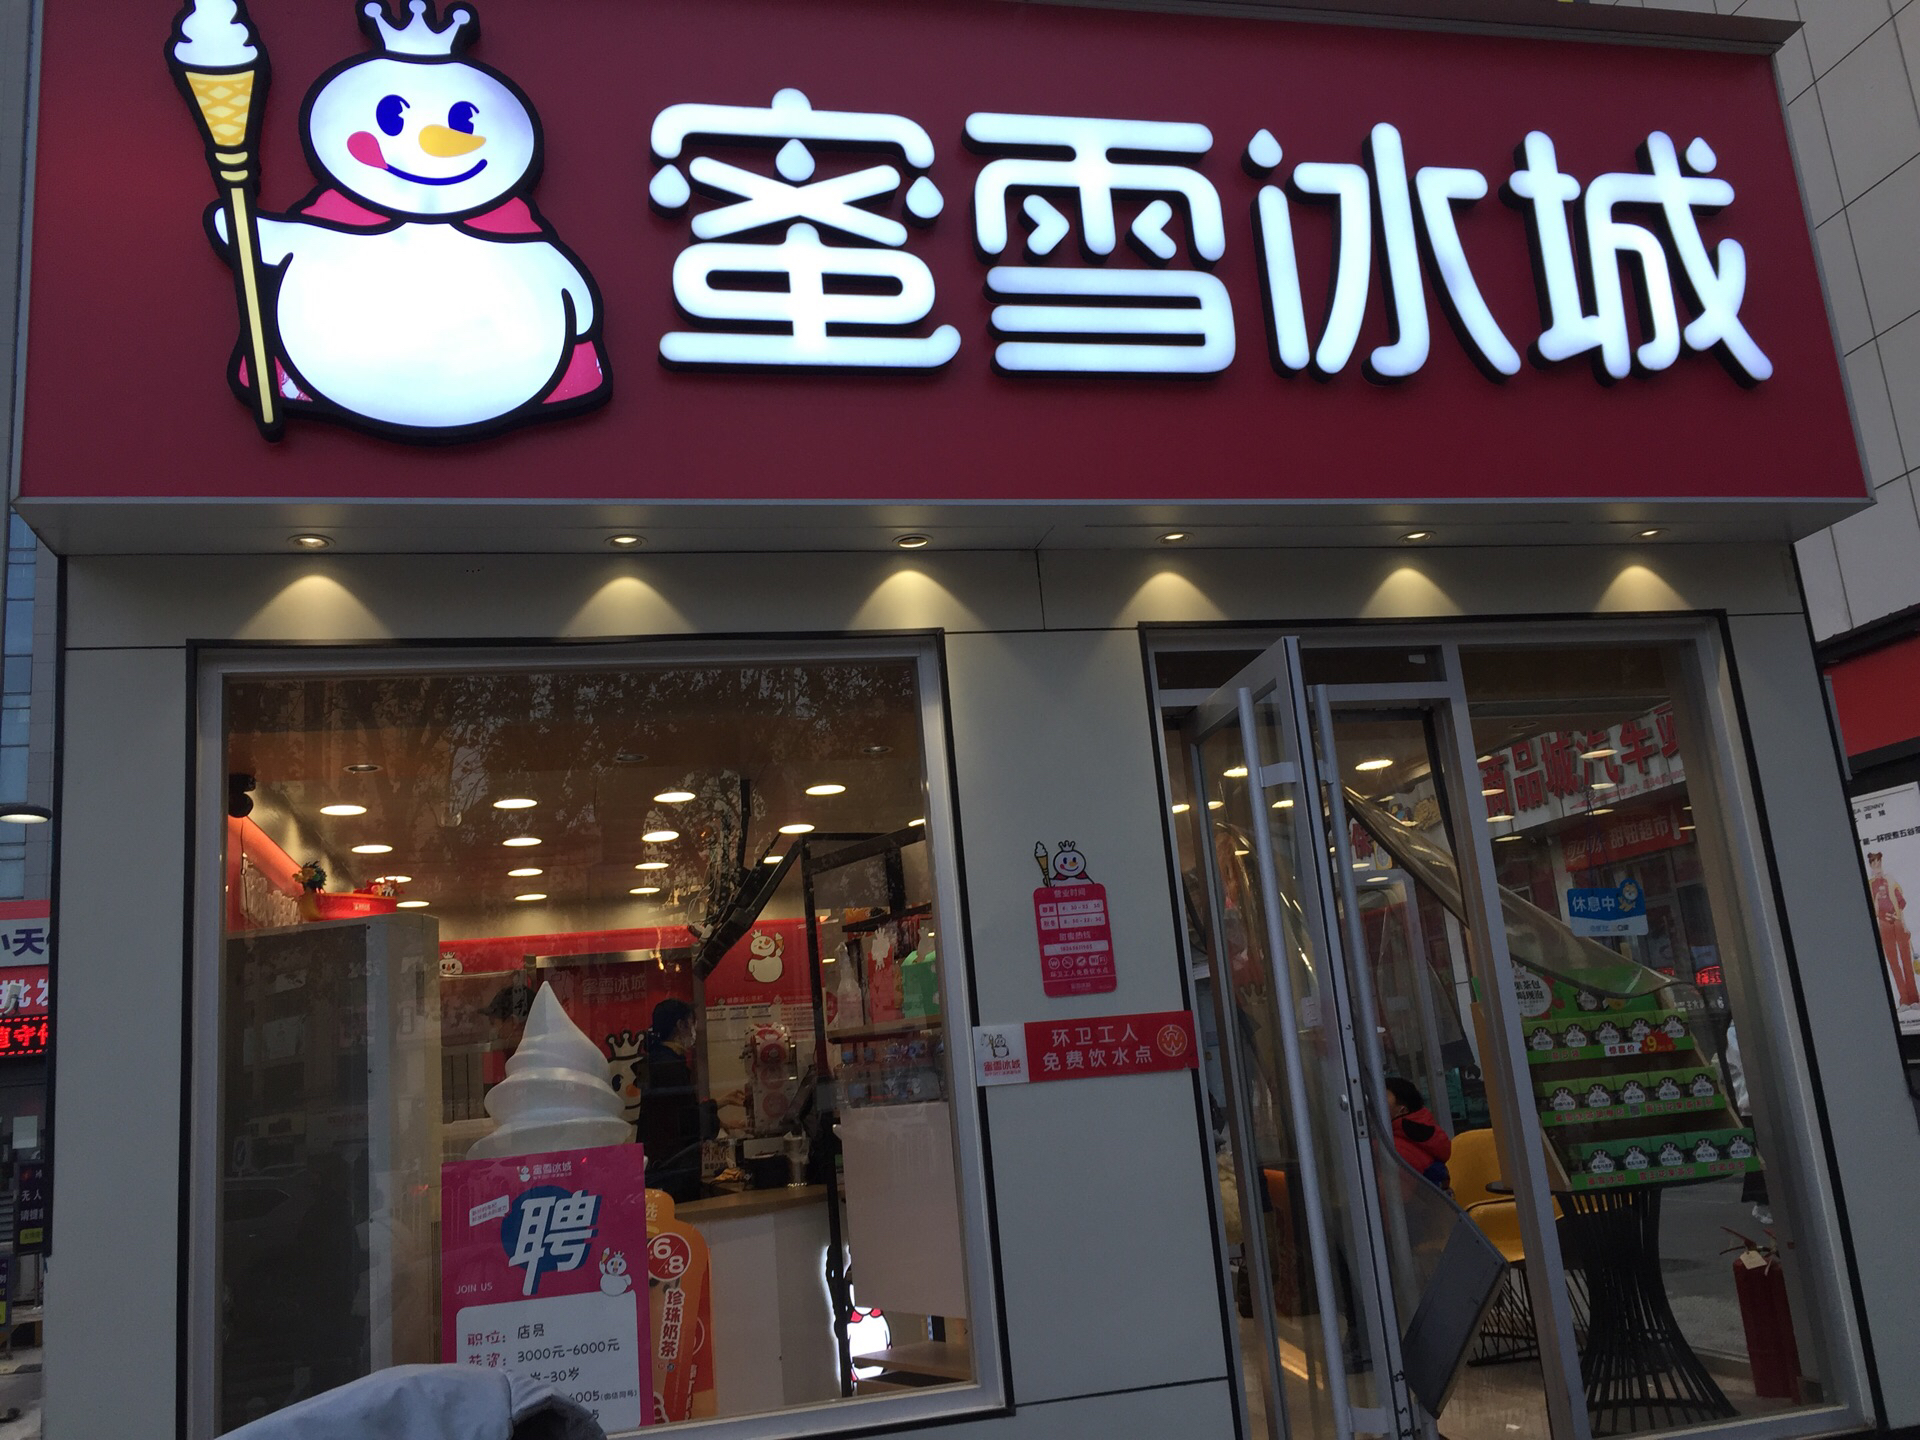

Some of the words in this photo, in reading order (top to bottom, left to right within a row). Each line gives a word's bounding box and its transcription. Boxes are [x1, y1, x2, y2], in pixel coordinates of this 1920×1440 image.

[650, 88, 1774, 382] 蜜雪冰城
[1572, 895, 1615, 913] 休息中
[1052, 1023, 1139, 1048] 环卫工人
[1042, 1046, 1153, 1072] 免费饮水点
[532, 1161, 572, 1175] 蜜雪冰城
[508, 1190, 602, 1296] 聘
[456, 1284, 477, 1295] JOIN
[480, 1282, 493, 1292] US
[517, 1323, 545, 1340] 店员
[660, 1290, 685, 1358] 珍珠奶茶
[517, 1338, 620, 1363] 3000元-6000元
